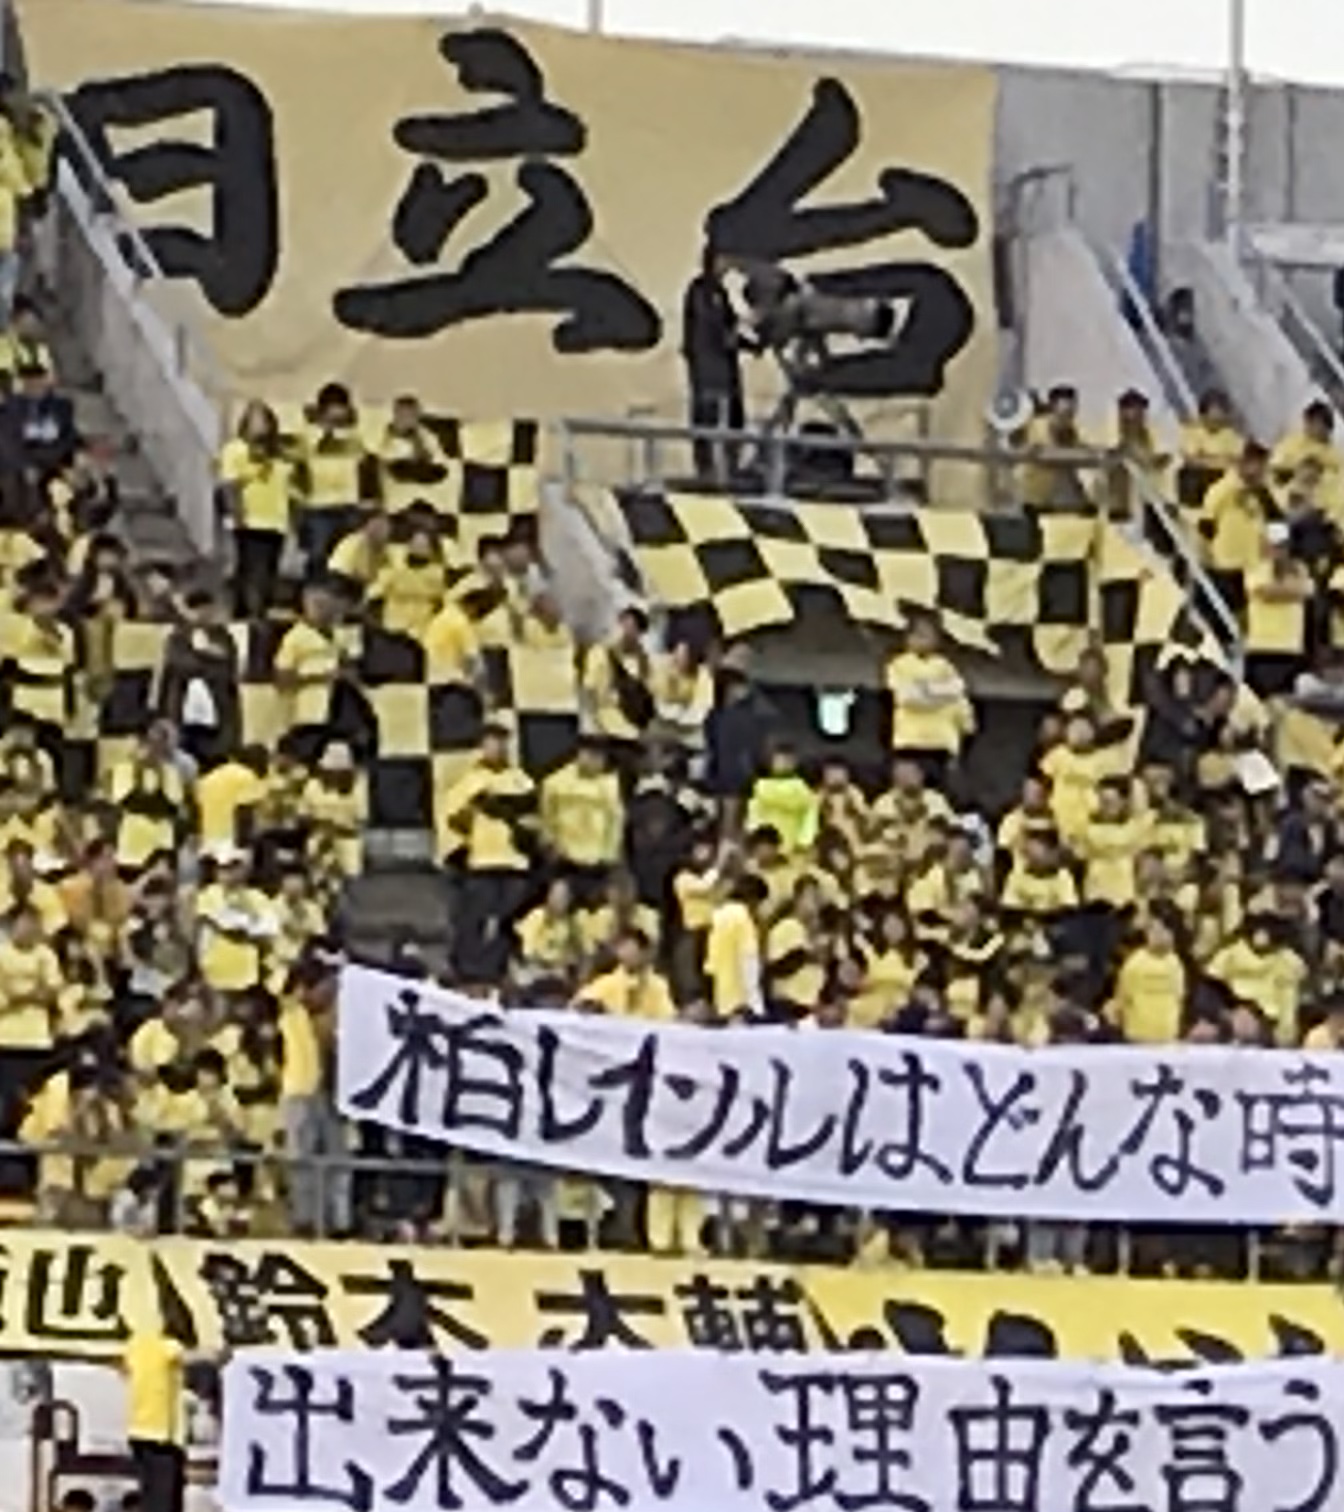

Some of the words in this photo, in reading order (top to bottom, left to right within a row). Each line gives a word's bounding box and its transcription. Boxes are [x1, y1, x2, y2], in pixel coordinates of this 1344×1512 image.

[60, 27, 979, 396] 日立台
[0, 1244, 134, 1342] 也
